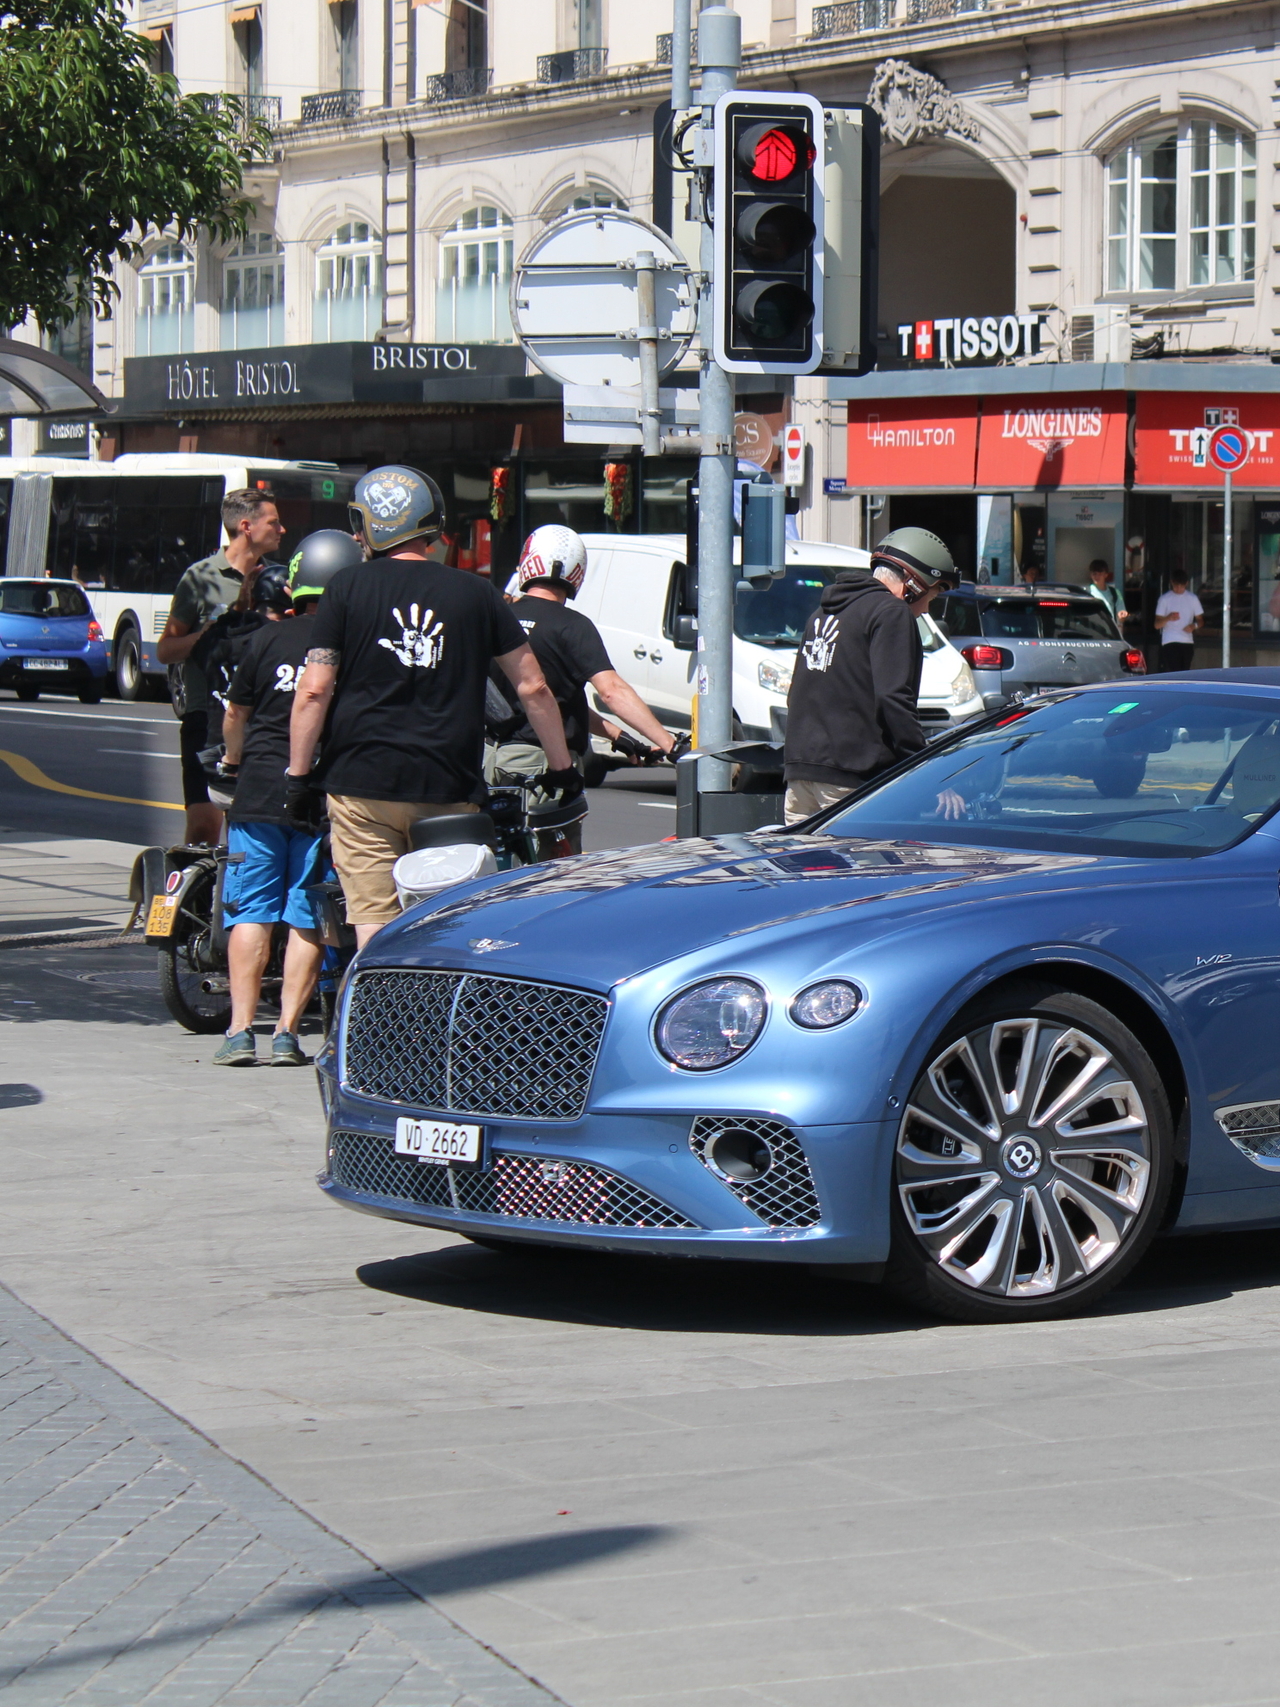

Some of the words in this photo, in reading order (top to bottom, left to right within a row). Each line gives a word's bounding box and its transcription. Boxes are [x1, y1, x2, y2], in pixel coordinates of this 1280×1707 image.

[934, 314, 1038, 362] TISSOT
[373, 346, 476, 371] BRISTOL
[236, 359, 300, 396] BRISTOL
[1002, 407, 1102, 438] LONGINES
[873, 428, 955, 447] HAMILTON
[322, 480, 335, 499] 9
[364, 471, 420, 490] CUSTOM
[152, 908, 172, 919] 108
[149, 922, 169, 933] 135
[1197, 953, 1232, 966] W12
